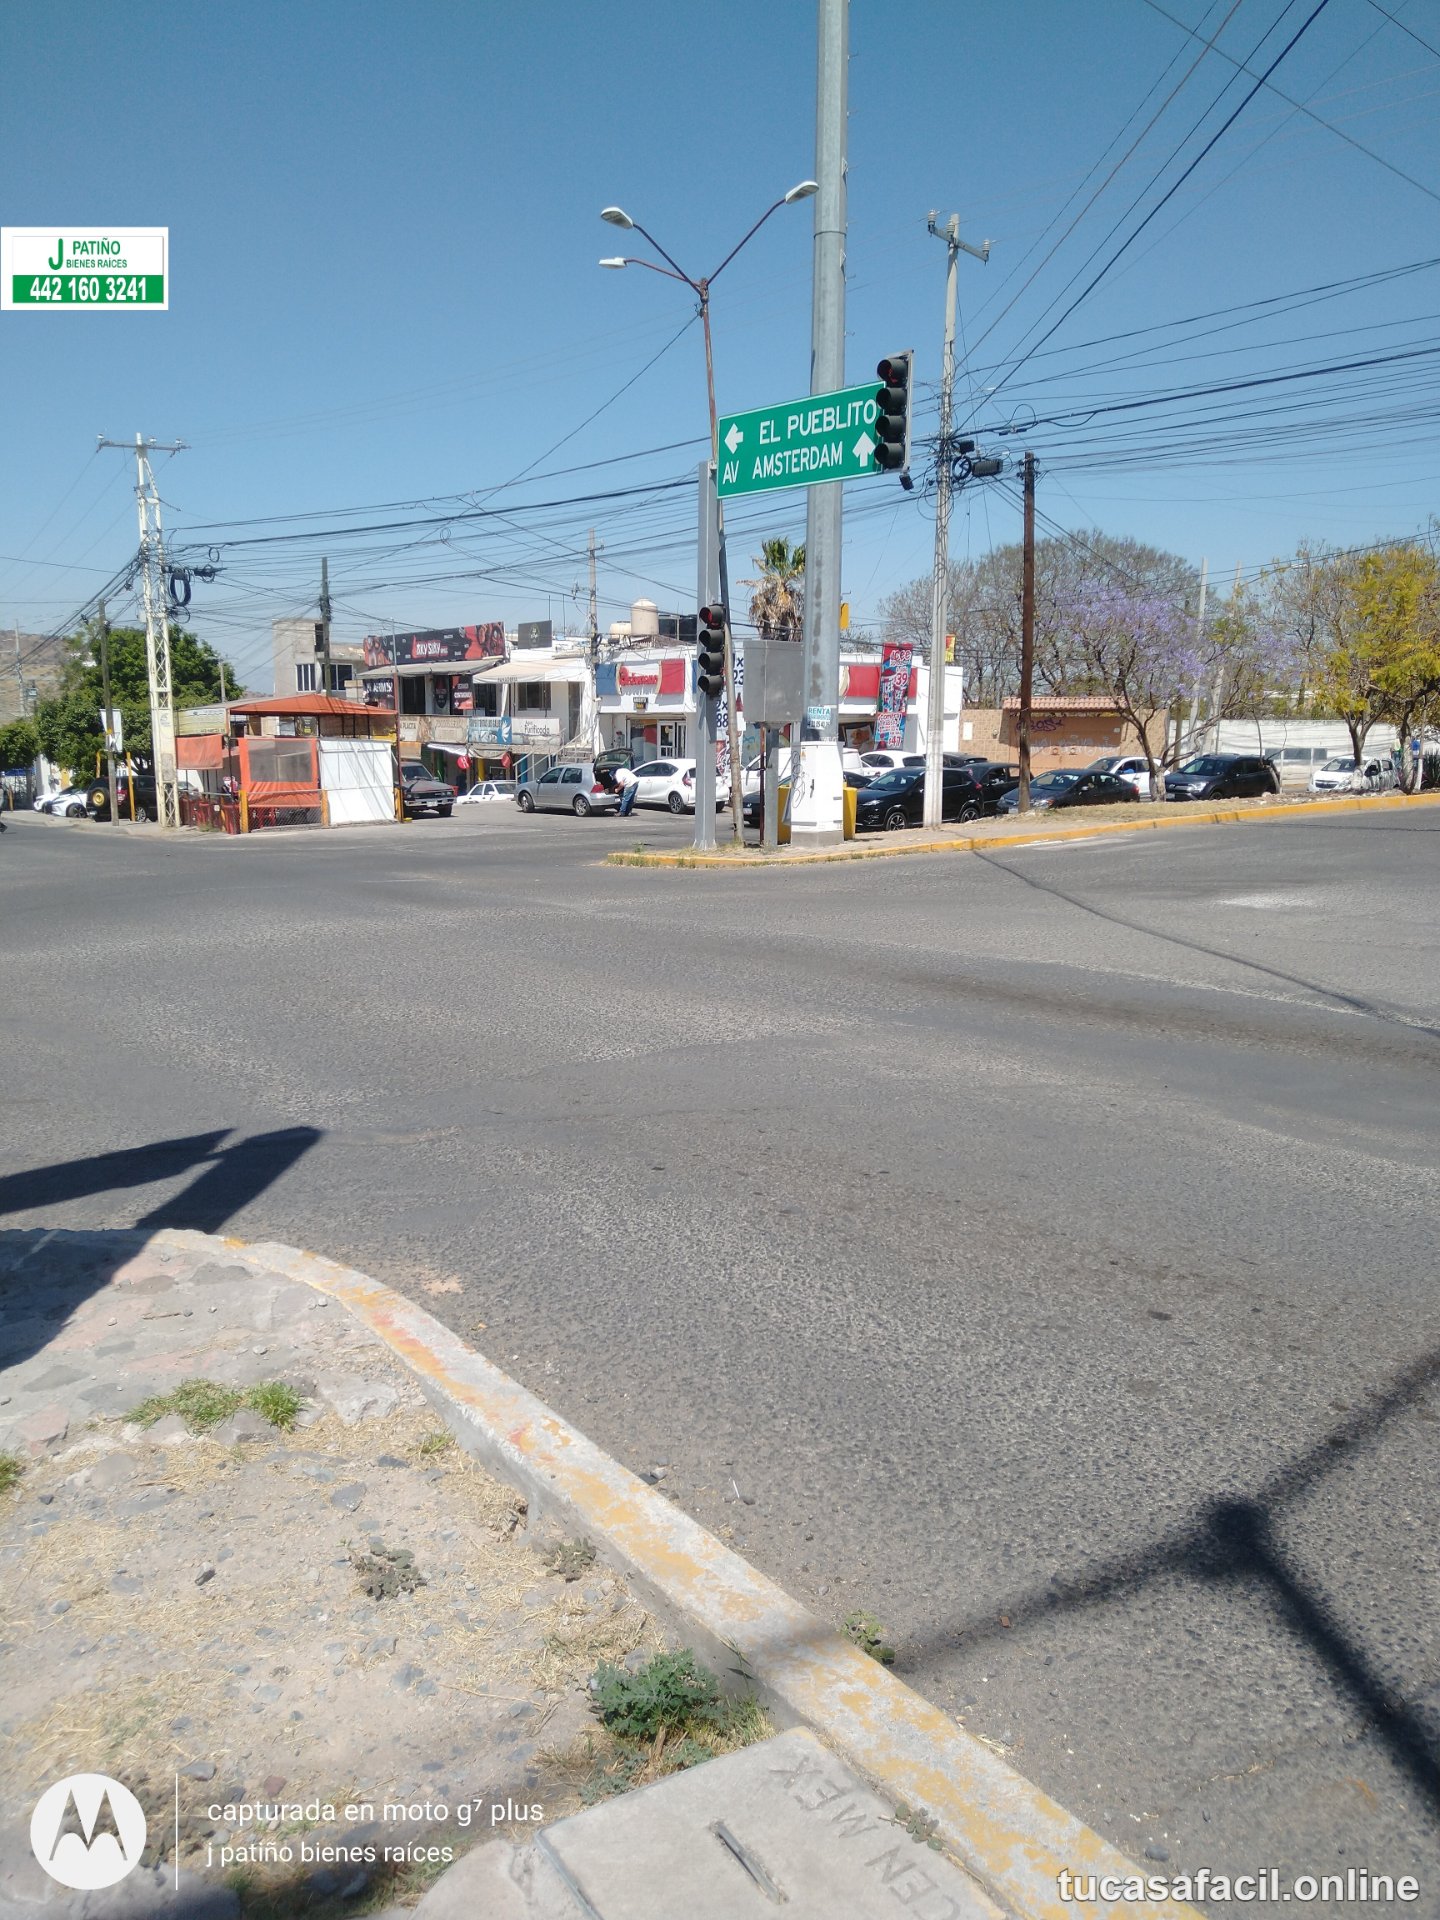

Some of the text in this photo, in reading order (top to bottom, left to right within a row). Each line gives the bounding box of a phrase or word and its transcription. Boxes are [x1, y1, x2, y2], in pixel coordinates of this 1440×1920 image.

[759, 398, 877, 445] EL PUEBLITO
[722, 440, 844, 485] AV AMSTERDAM
[808, 707, 831, 715] RENTA
